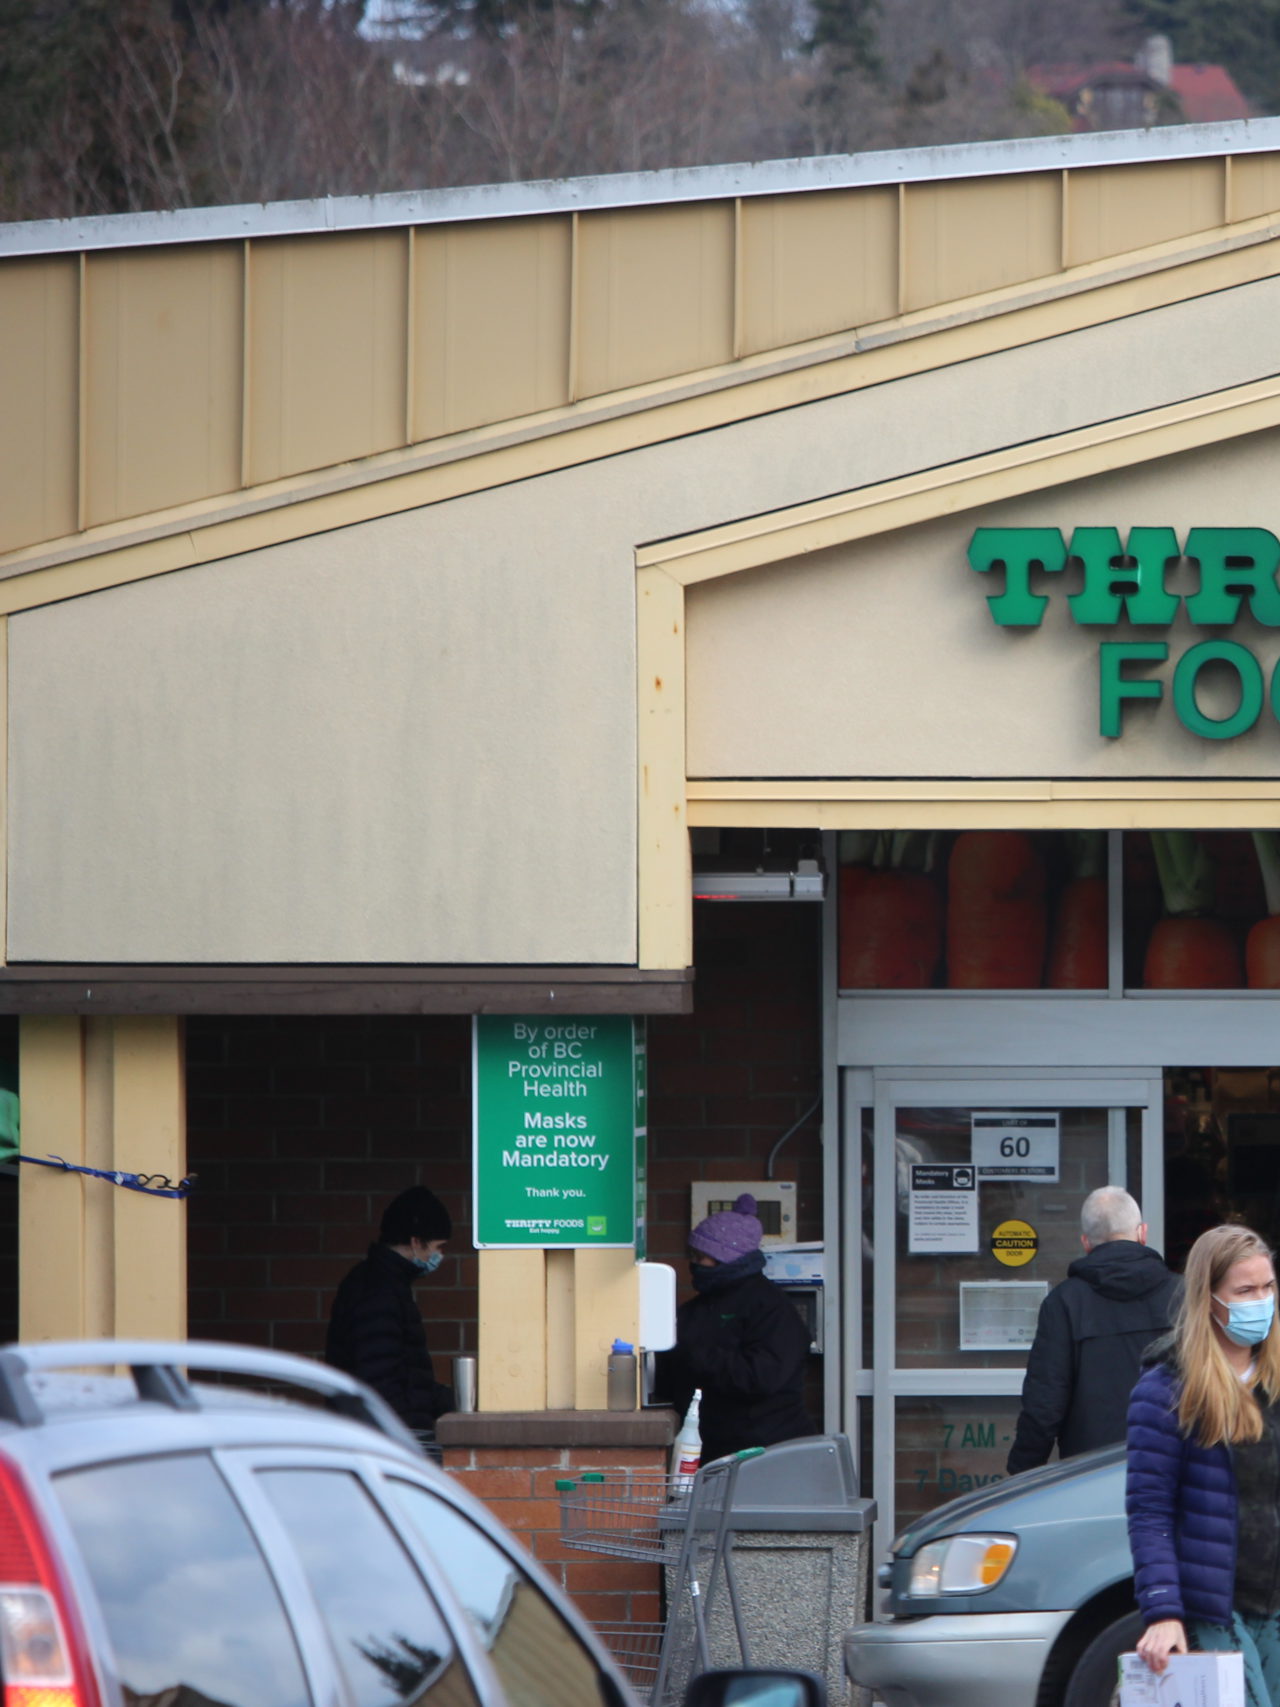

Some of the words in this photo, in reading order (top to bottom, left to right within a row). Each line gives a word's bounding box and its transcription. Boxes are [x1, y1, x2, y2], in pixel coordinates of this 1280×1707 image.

[514, 1023, 538, 1042] By
[544, 1024, 597, 1040] order
[528, 1042, 548, 1059] of
[554, 1042, 583, 1059] BC
[508, 1061, 603, 1078] Provincial
[523, 1080, 587, 1097] Health
[524, 1112, 587, 1129] Masks
[515, 1135, 547, 1148] are
[554, 1135, 596, 1148] now
[1000, 1136, 1030, 1158] 60
[502, 1150, 609, 1171] Mandatory
[525, 1187, 560, 1198] Thank
[562, 1189, 586, 1199] you.
[504, 1219, 552, 1228] THRIFTY
[553, 1219, 584, 1228] FOODS
[995, 1240, 1033, 1248] CAUTION
[942, 1424, 955, 1448] 7
[961, 1423, 996, 1448] AM
[914, 1469, 929, 1493] 7
